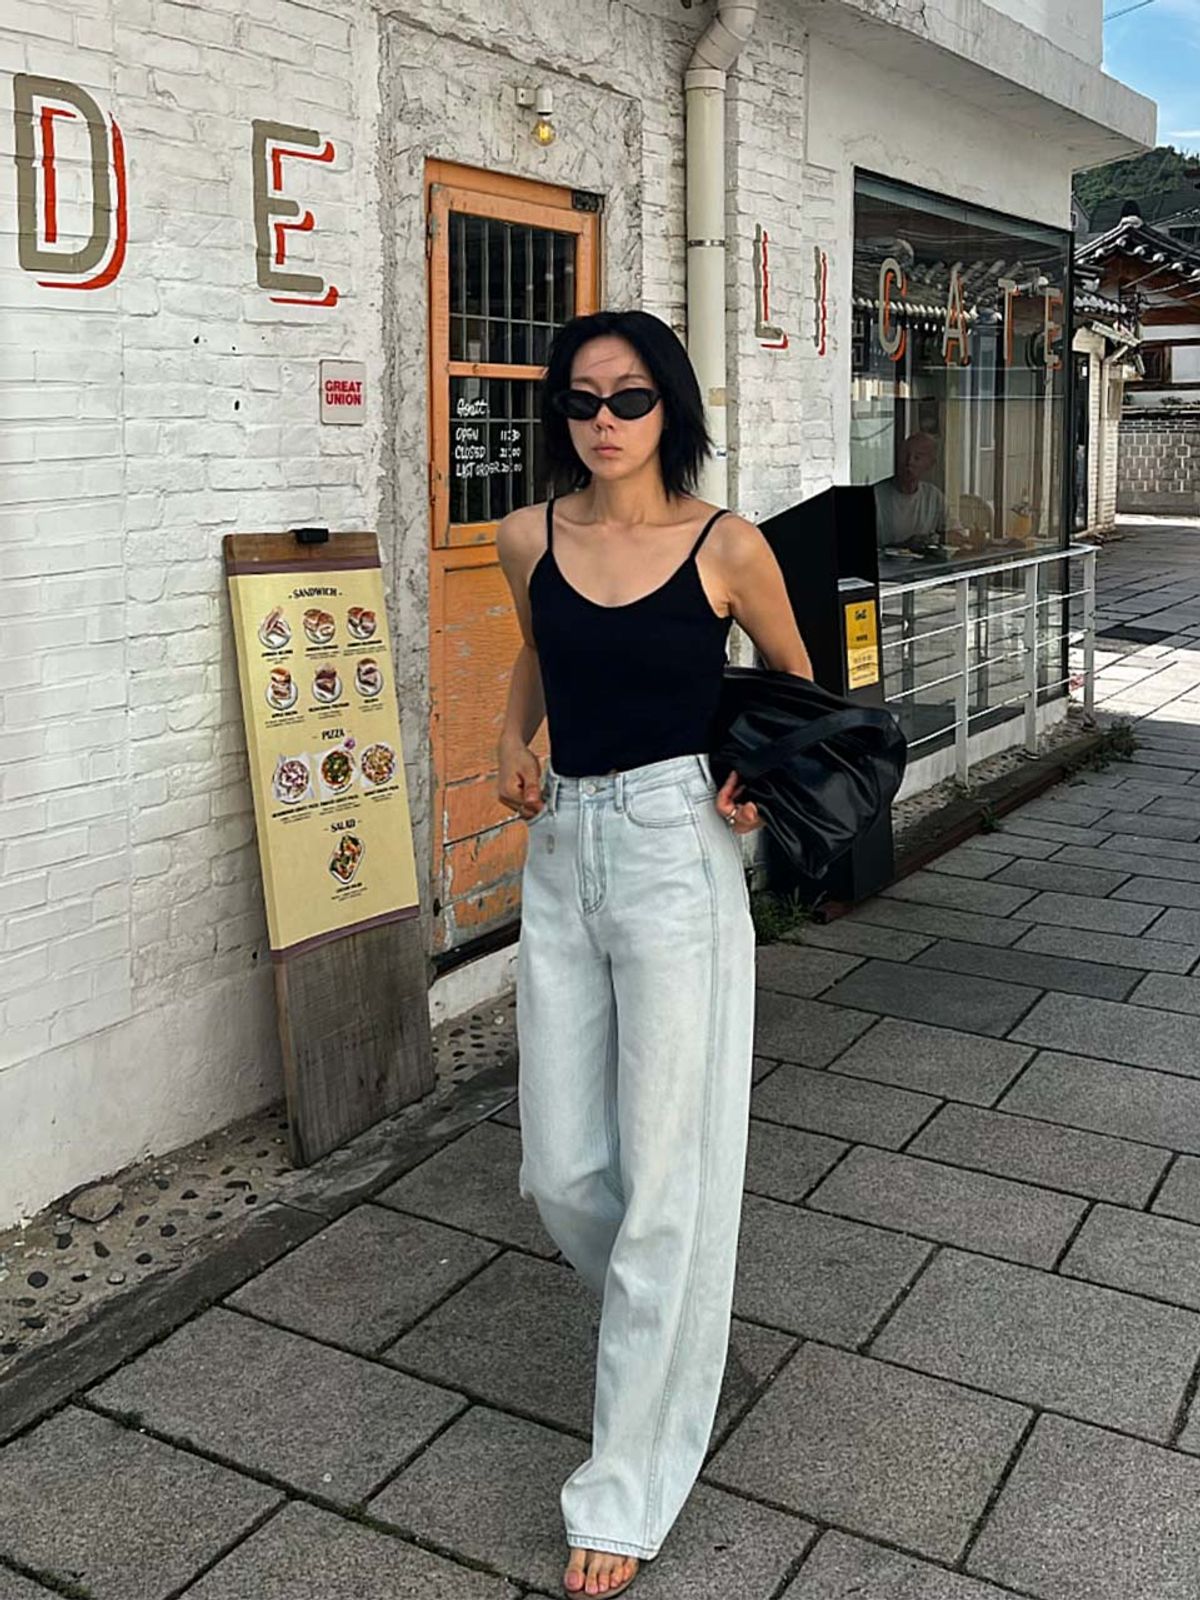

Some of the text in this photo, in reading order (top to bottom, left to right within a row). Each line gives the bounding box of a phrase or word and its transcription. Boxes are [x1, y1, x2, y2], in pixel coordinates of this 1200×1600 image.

[325, 380, 363, 393] GREAT
[326, 393, 362, 406] UNION
[455, 427, 479, 442] OPEN
[454, 444, 487, 460] CLOSED
[293, 587, 337, 599] SANDWICH
[321, 728, 345, 740] PIZZA
[330, 818, 356, 833] SALAD
